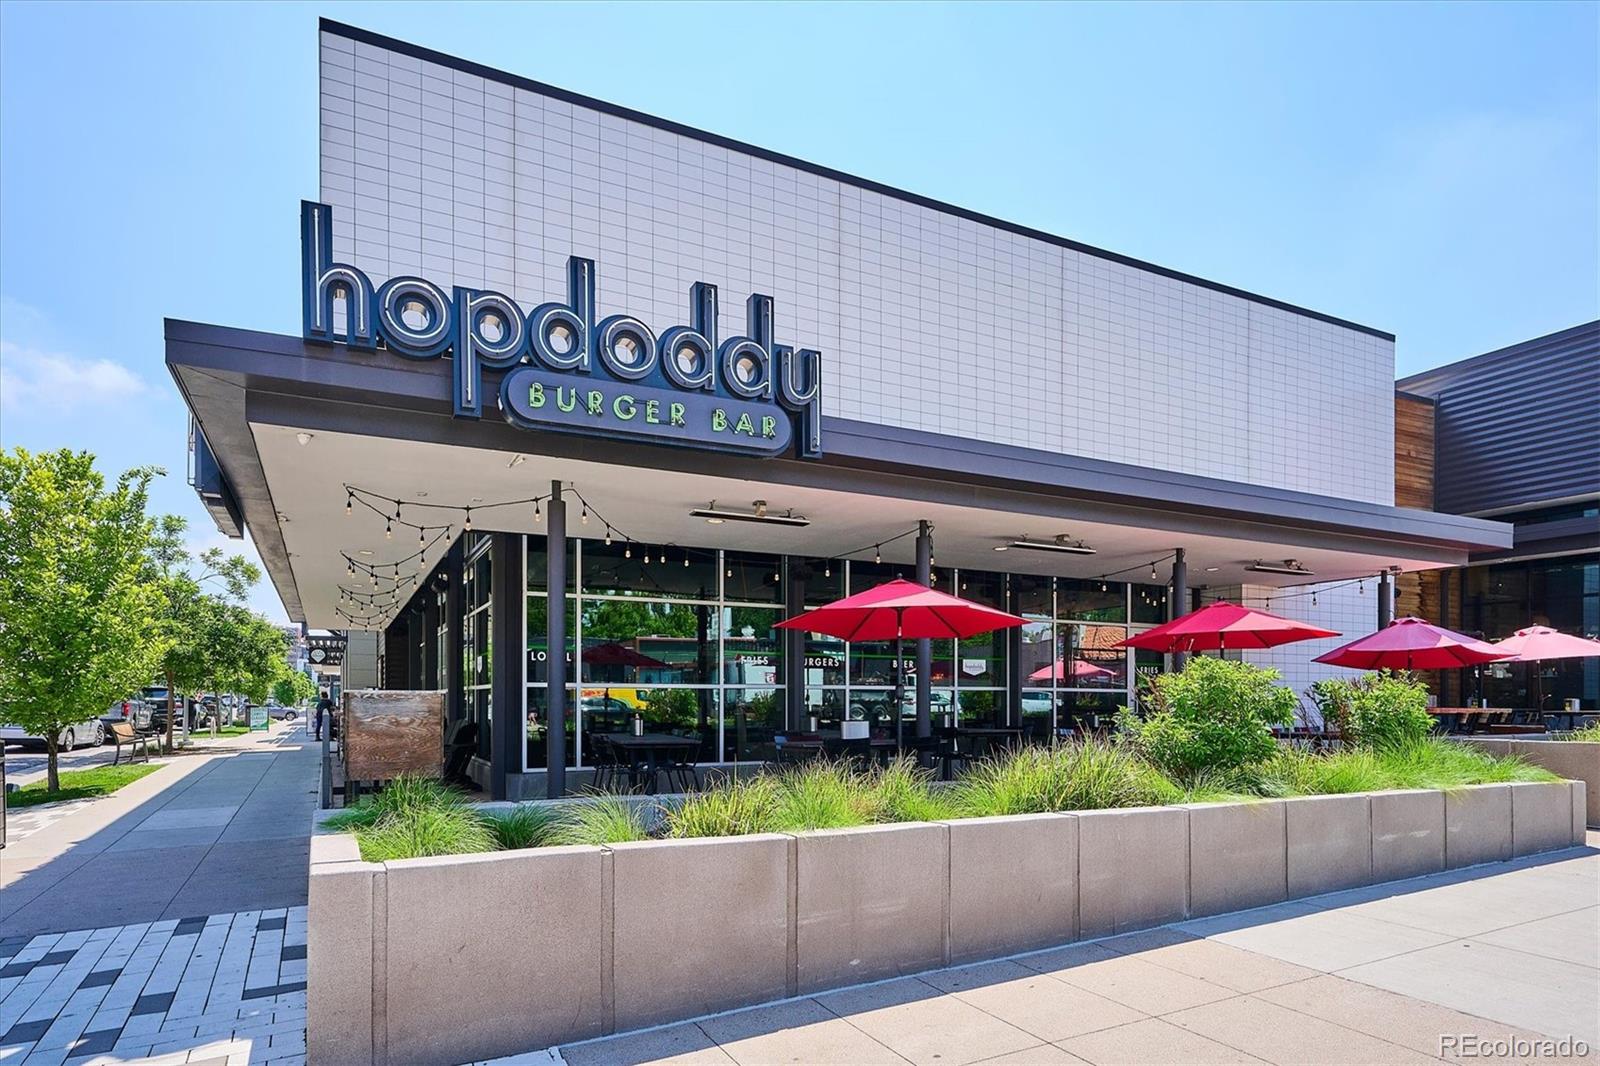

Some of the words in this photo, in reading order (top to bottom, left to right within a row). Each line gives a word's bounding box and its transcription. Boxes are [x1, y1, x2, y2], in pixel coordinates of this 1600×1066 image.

[301, 200, 822, 459] hopdoddy
[529, 382, 686, 427] BURGER
[712, 408, 777, 439] BAR
[531, 651, 572, 661] LOL
[804, 657, 839, 667] URGERS
[892, 660, 913, 668] BER
